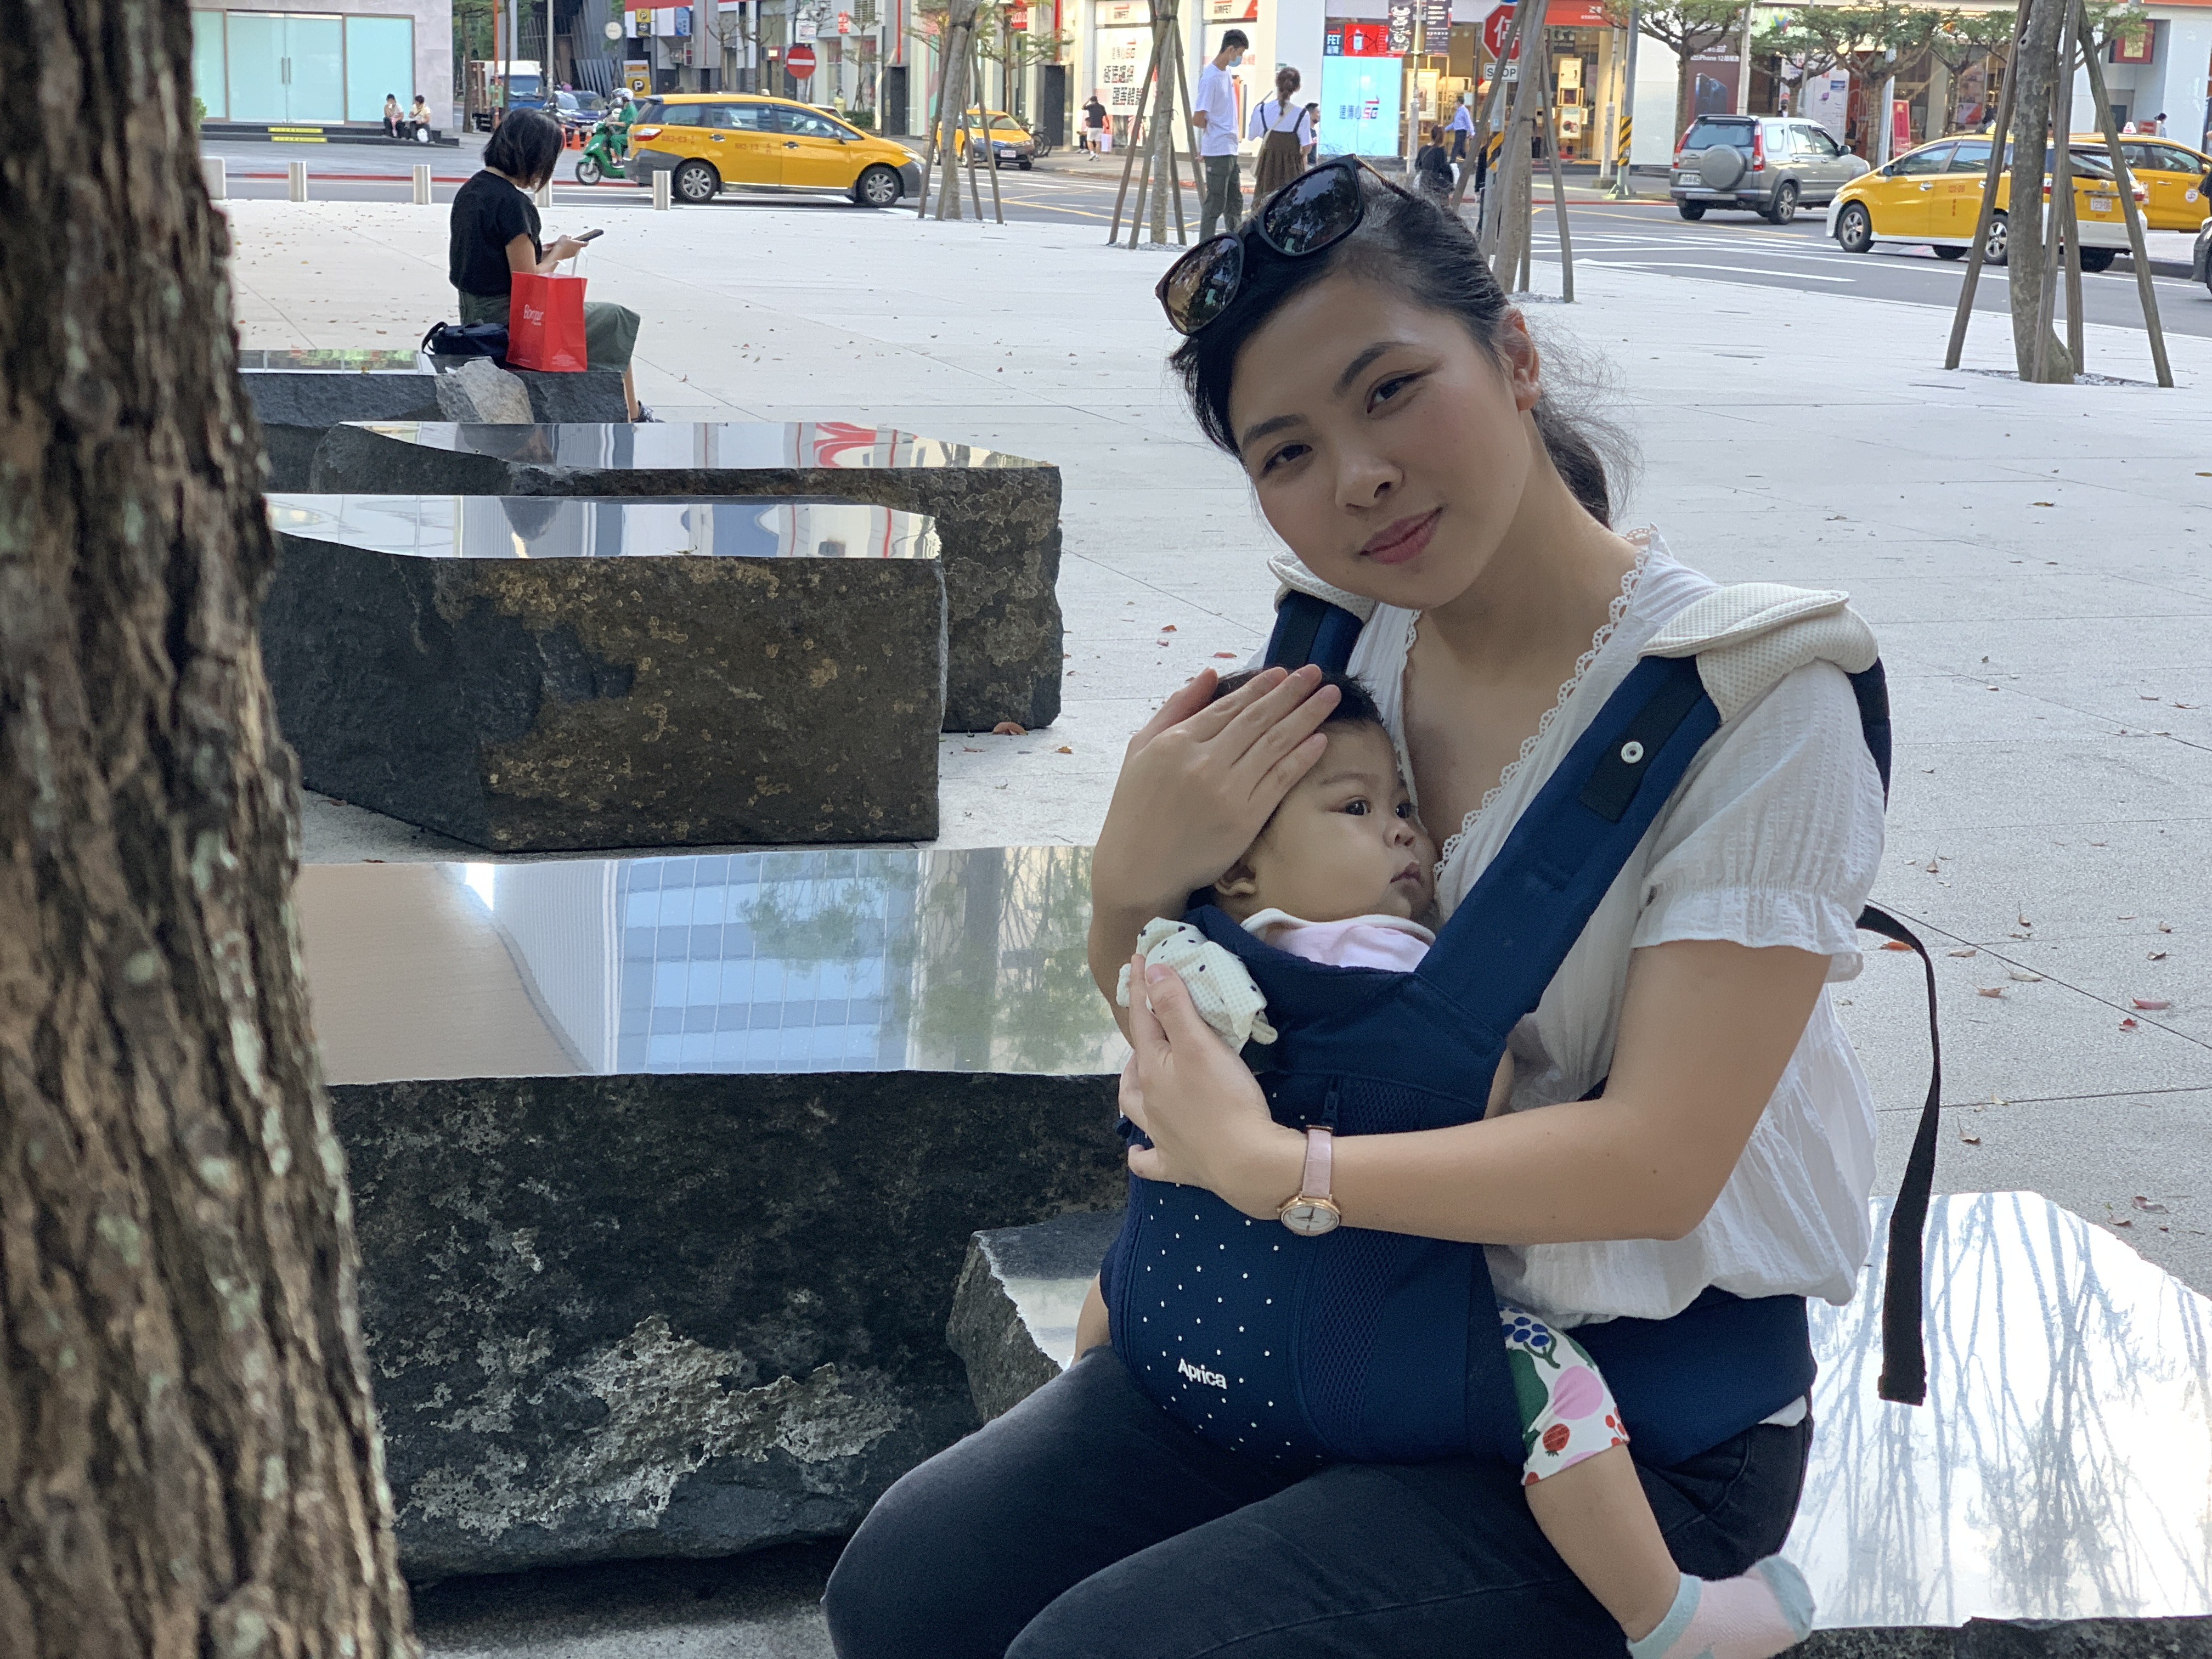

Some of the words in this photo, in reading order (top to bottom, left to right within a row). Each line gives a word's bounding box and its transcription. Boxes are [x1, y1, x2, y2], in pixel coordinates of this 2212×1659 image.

[1328, 35, 1341, 44] FET
[1487, 67, 1516, 77] SOP
[634, 81, 644, 91] P
[1177, 1358, 1227, 1390] Aprica
